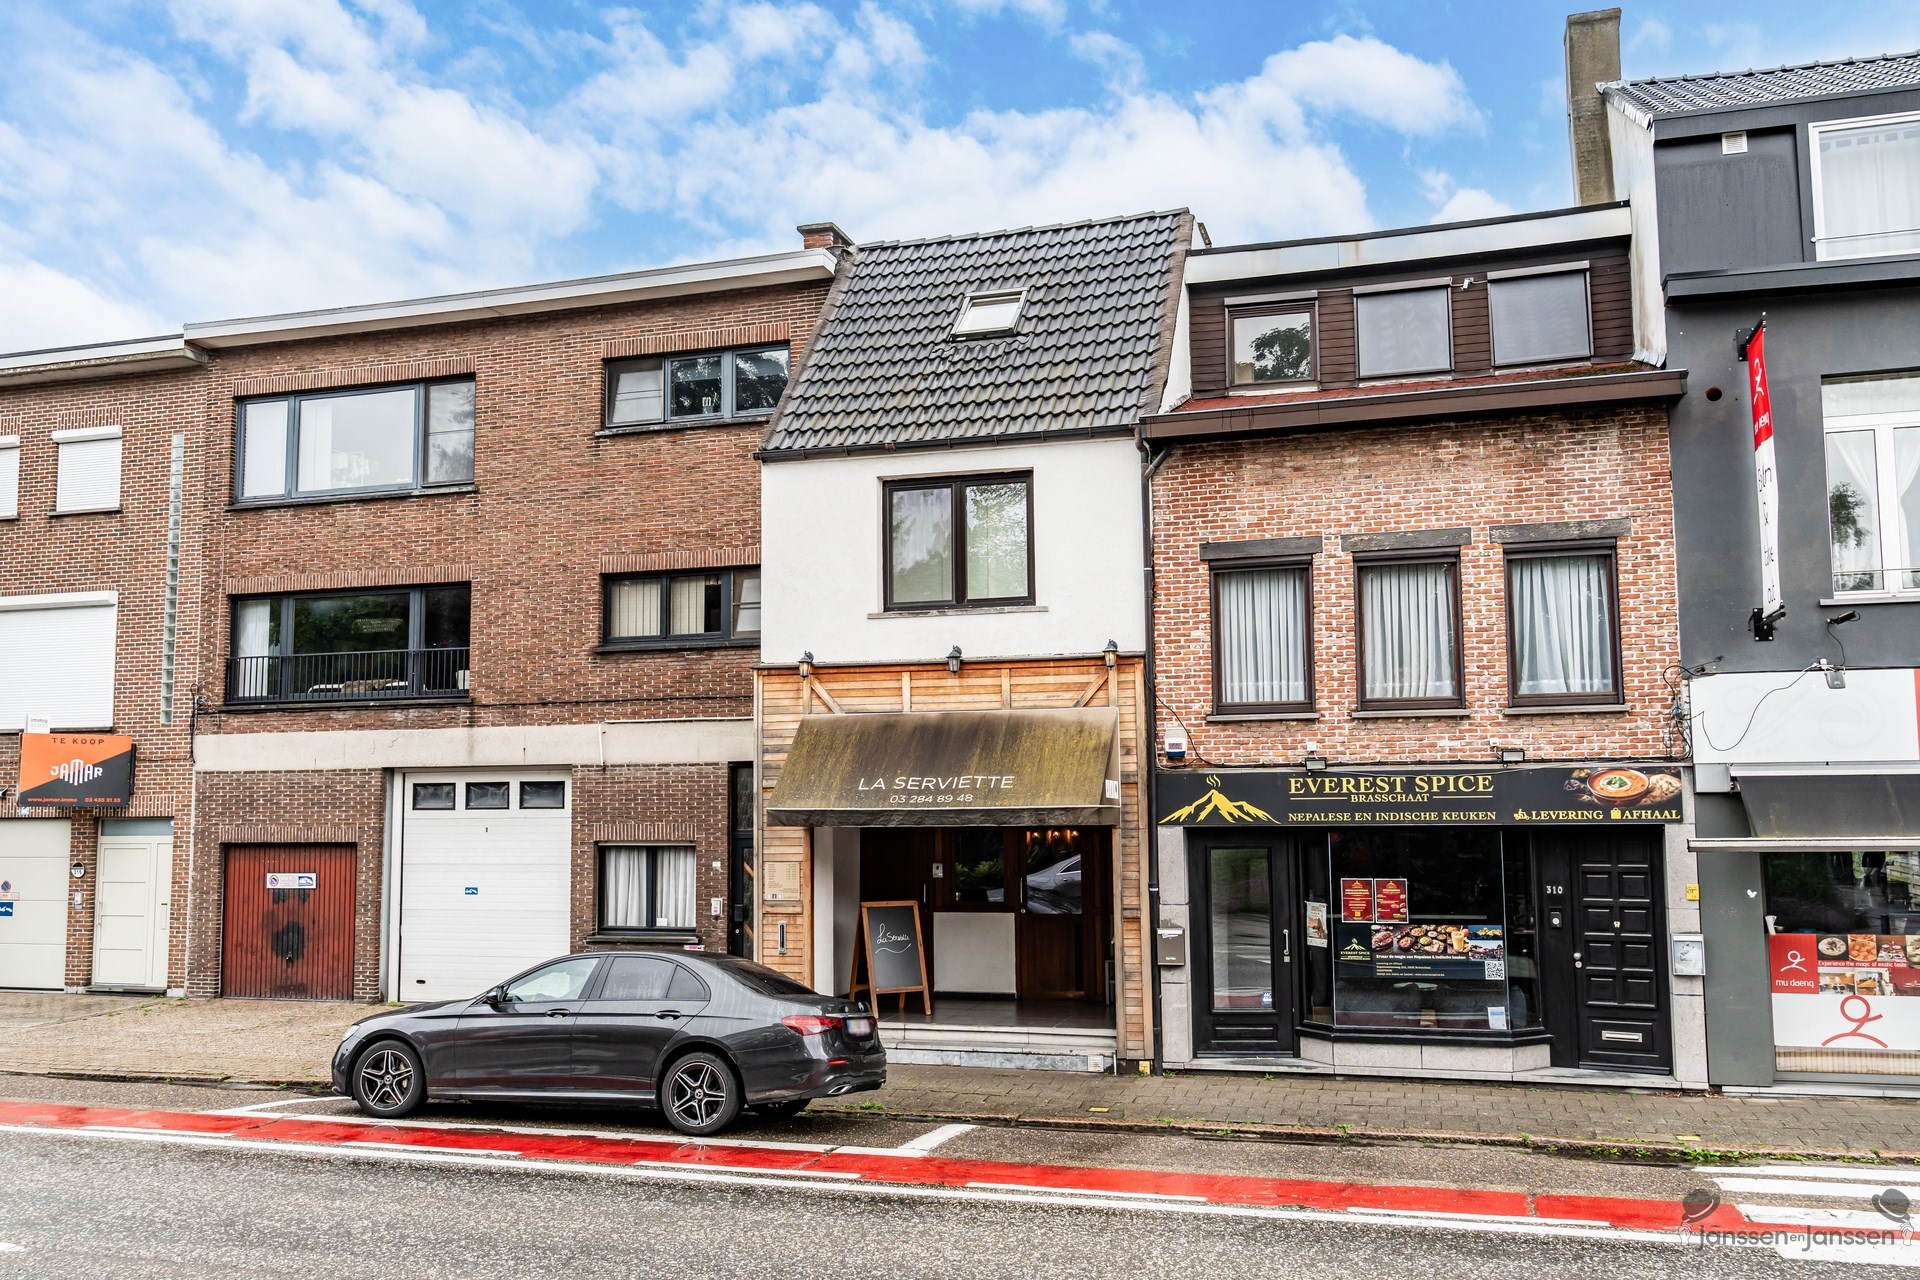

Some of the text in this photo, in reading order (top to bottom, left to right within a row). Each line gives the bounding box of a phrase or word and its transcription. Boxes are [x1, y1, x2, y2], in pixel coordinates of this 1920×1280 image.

[50, 758, 103, 786] JAMAR
[858, 775, 1015, 791] LA SERVIETTE
[1288, 775, 1495, 794] EVEREST SPICE
[890, 793, 974, 804] 03 284 89 48
[1350, 793, 1430, 803] BRASSCHAAT
[1287, 811, 1496, 822] NEPALESE EN INDISCHE KEUKEN
[1531, 809, 1681, 820] LEVERING AFHAAL
[1546, 885, 1563, 895] 310
[876, 923, 888, 944] La
[1818, 960, 1845, 968] Experience
[1775, 979, 1788, 987] mu
